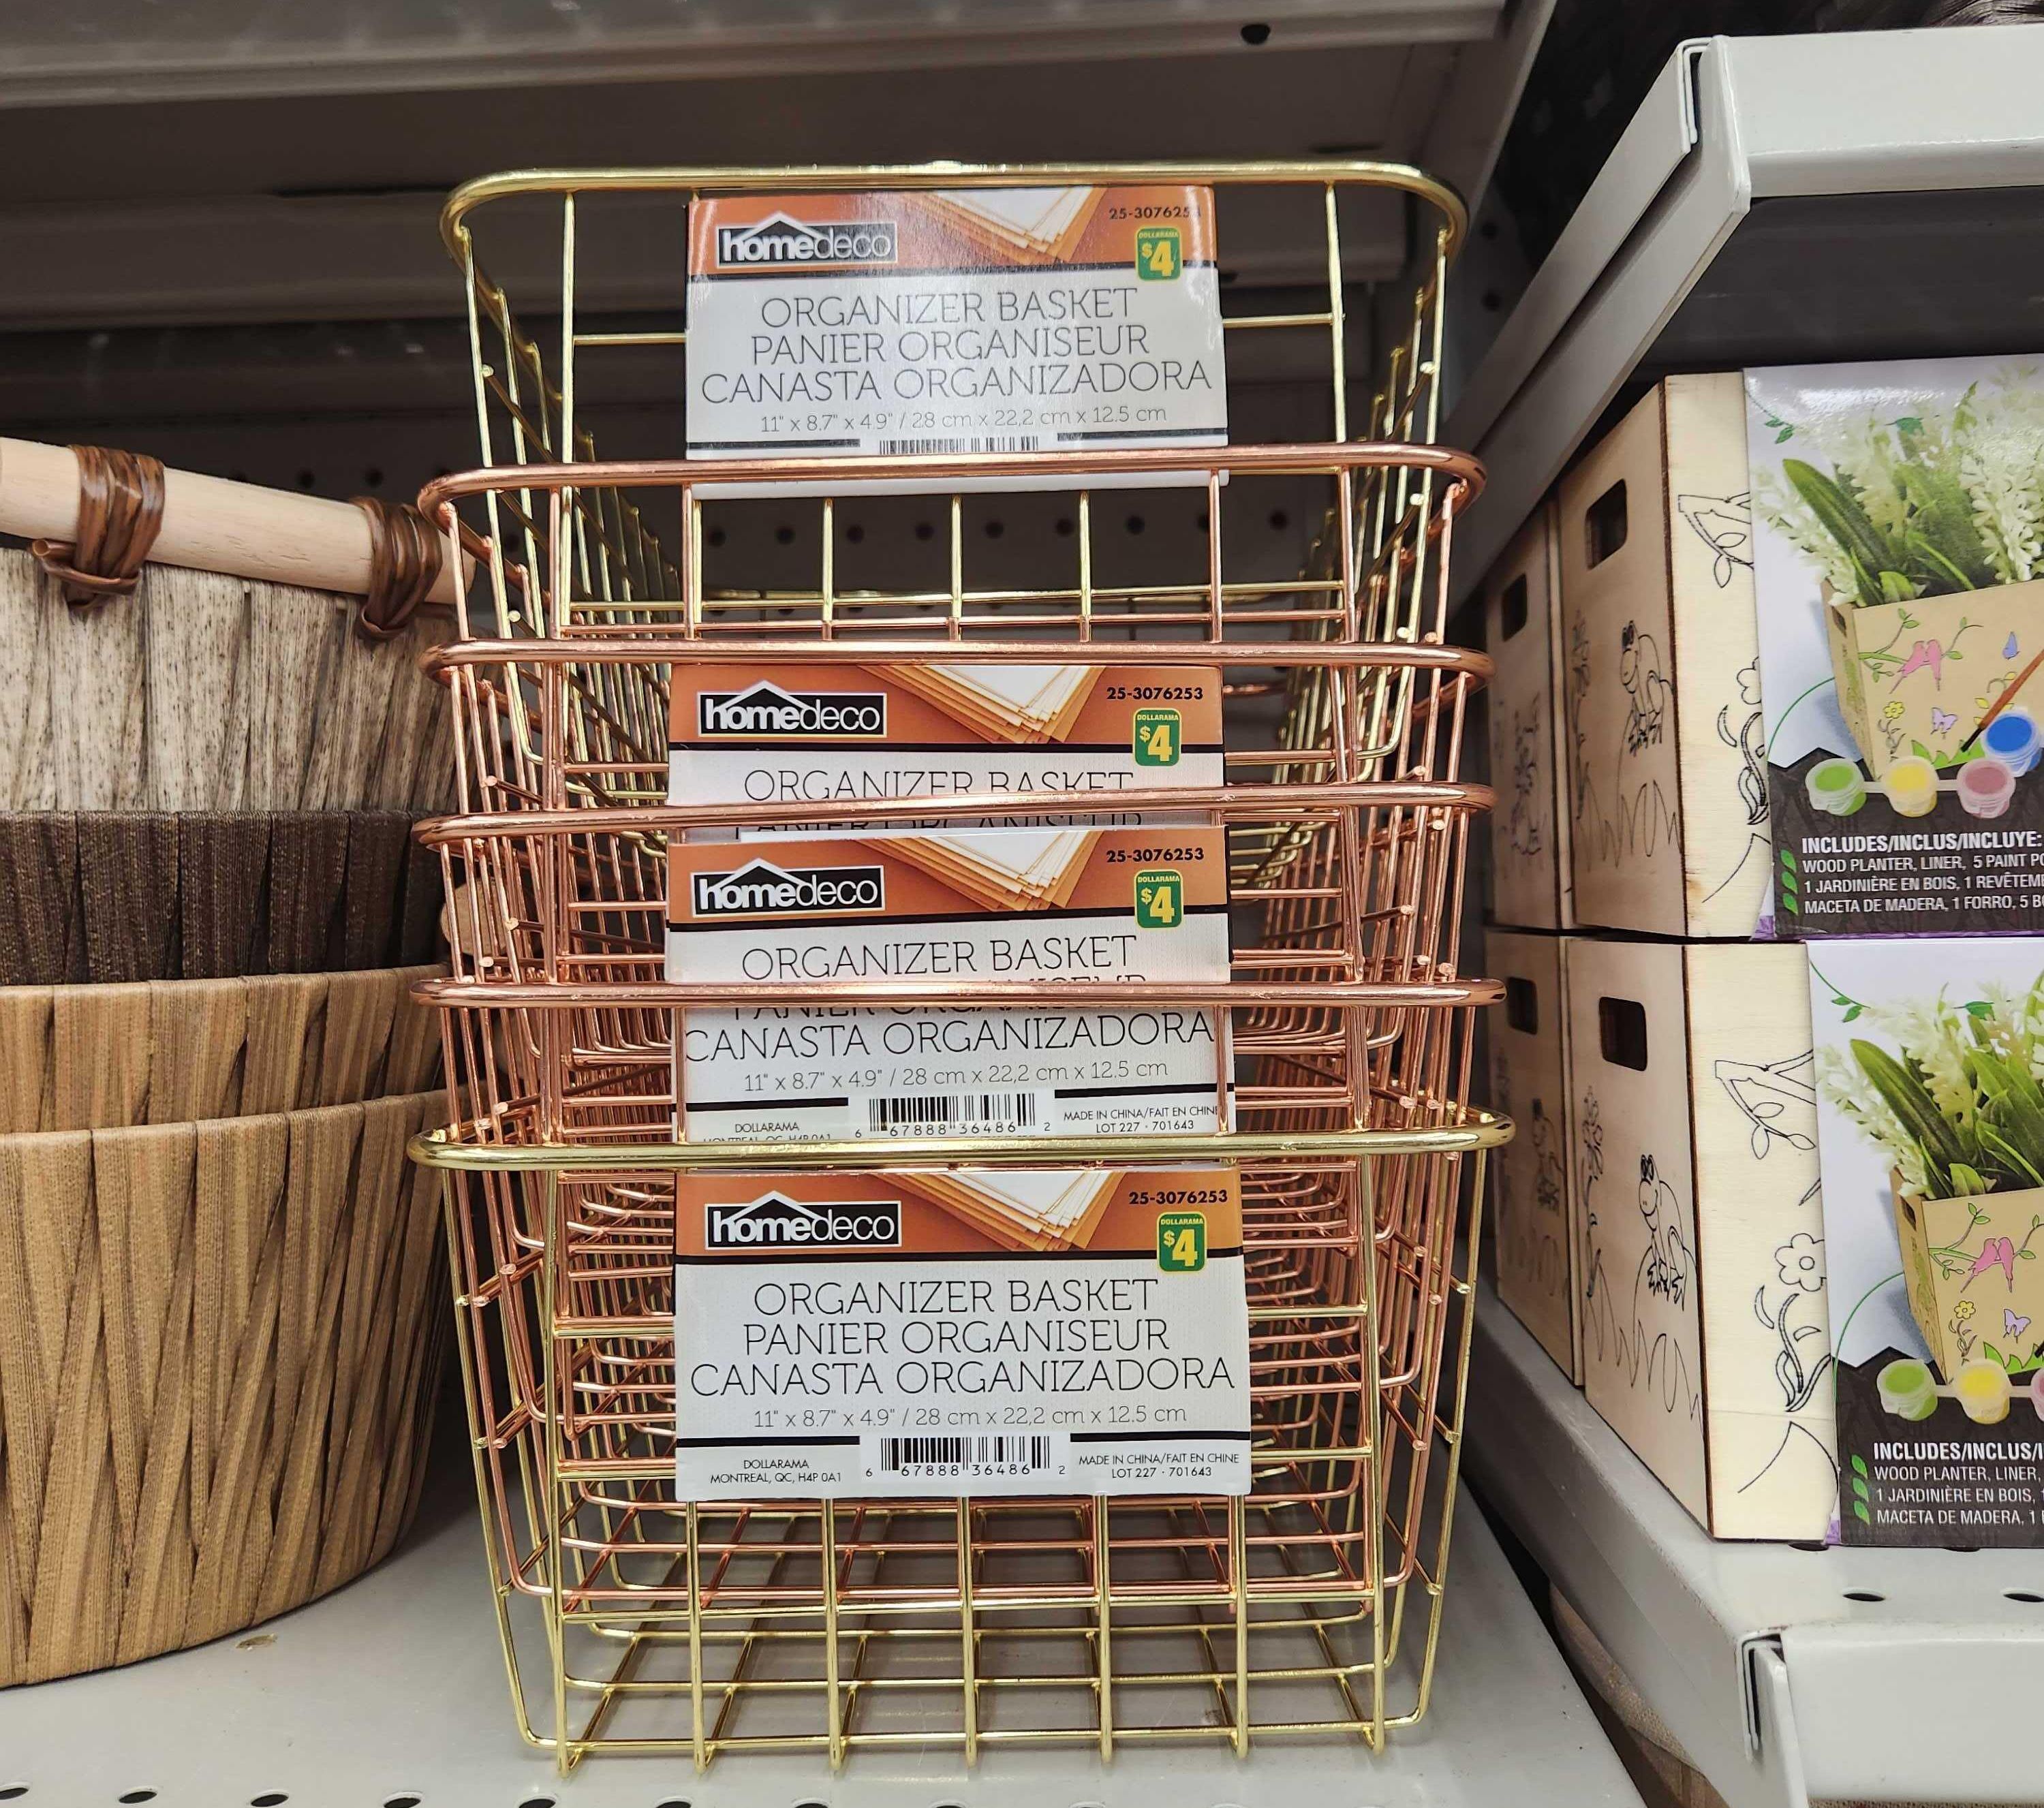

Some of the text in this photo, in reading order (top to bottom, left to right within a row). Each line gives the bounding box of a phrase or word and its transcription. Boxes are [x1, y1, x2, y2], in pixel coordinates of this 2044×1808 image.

[722, 227, 891, 262] homedeco
[1141, 240, 1174, 277] $4
[762, 288, 1137, 328] ORGANIZER BASKET
[752, 325, 1149, 365] PANIER ORGANISEUR
[702, 360, 1212, 403] CANASTA ORGANIZADORA
[761, 415, 784, 433] 11"
[790, 419, 800, 431] x
[807, 414, 837, 432] 8.7"
[844, 418, 854, 430] x
[860, 413, 893, 431] 4.9"
[899, 413, 905, 429] /
[912, 412, 935, 428] 28
[942, 414, 972, 428] cm
[978, 414, 988, 426] x
[1040, 410, 1071, 424] cm
[1077, 411, 1087, 424] x
[1093, 406, 1129, 423] 12.5
[1136, 407, 1166, 422] cm
[1106, 686, 1203, 700] 25-3076253
[705, 698, 880, 731] homedeco
[1139, 725, 1173, 762] $4
[1801, 830, 2042, 854] INCLUDES/INCLUS/INCLUYE:
[1106, 847, 1205, 863] 25-3076253
[1803, 859, 1846, 873] WOOD
[1850, 857, 1917, 872] PLANTER,
[1921, 856, 1966, 871] LINER,
[1973, 855, 1983, 869] 5
[1985, 854, 2028, 867] PAINT
[699, 875, 878, 910] homedeco
[1805, 881, 1811, 893] 1
[1815, 875, 1898, 893] JARDINIÈRE
[1901, 878, 1919, 891] EN
[1923, 877, 1960, 892] BOIS,
[1964, 875, 1971, 889] 1
[1141, 886, 1175, 923] $4
[1805, 894, 2044, 914] MACETA DE MADERA, 1 FORRO, 5 B
[743, 935, 1136, 980] ORGANIZER BASKET
[685, 1011, 1215, 1061] CANASTA ORGANIZADORA
[745, 1073, 768, 1091] 11"
[775, 1077, 786, 1090] x
[792, 1072, 825, 1090] 8.7"
[832, 1075, 842, 1088] x
[848, 1069, 882, 1088] 4.9"
[889, 1067, 896, 1087] /
[903, 1068, 927, 1086] 28
[934, 1070, 965, 1085] cm
[972, 1070, 982, 1083] x
[1036, 1066, 1068, 1081] cm
[1074, 1067, 1085, 1080] x
[1091, 1061, 1129, 1079] 12.5
[1136, 1061, 1168, 1076] cm
[1064, 1110, 1094, 1121] MADE
[1096, 1110, 1107, 1120] IN
[1111, 1106, 1169, 1119] CHINA/FAIT
[1173, 1106, 1186, 1117] EN
[735, 1122, 799, 1133] DOLLARAMA
[855, 1121, 1051, 1138] 6 67888 36486 2
[1096, 1123, 1116, 1134] LOT
[1119, 1121, 1140, 1132] 227
[1152, 1119, 1194, 1131] 701643
[1129, 1189, 1228, 1204] 25-3076253
[713, 1209, 895, 1243] homedeco
[1163, 1229, 1198, 1266] $4
[755, 1279, 1158, 1315] ORGANIZER BASKET
[744, 1319, 1169, 1355] PANIER ORGANISEUR
[691, 1357, 1235, 1396] CANASTA ORGANIZADORA
[754, 1410, 778, 1427] 11"
[785, 1414, 796, 1427] x
[803, 1409, 836, 1427] 8.7"
[843, 1414, 854, 1427] x
[860, 1409, 895, 1427] 4.9"
[901, 1407, 910, 1427] /
[916, 1408, 940, 1425] 28
[948, 1411, 980, 1425] cm
[986, 1412, 997, 1424] x
[1052, 1409, 1083, 1424] cm
[1090, 1410, 1102, 1423] x
[1109, 1405, 1147, 1423] 12.5
[1154, 1407, 1186, 1422] cm
[744, 1459, 809, 1469] DOLLARAMA
[1079, 1452, 1239, 1465] MADE IN CHINA/FAIT EN CHINE
[711, 1472, 841, 1484] MONTREAL, QC, H4P 0A1
[866, 1465, 1066, 1477] 6 67888 36486 2
[1112, 1468, 1132, 1478] LOT
[1135, 1467, 1156, 1478] 227
[1169, 1467, 1211, 1477] 701643
[1874, 1466, 2041, 1482] WOOD PLANTER, LINER,
[1877, 1489, 1883, 1502] 1
[1889, 1485, 1972, 1502] JARDINIÈRE
[1977, 1488, 1994, 1503] EN
[1999, 1488, 2035, 1504] BOIS,
[1877, 1510, 1934, 1525] MACETA
[1938, 1510, 1956, 1525] DE
[1960, 1510, 2024, 1526] MADERA,
[2029, 1510, 2035, 1525] 1
